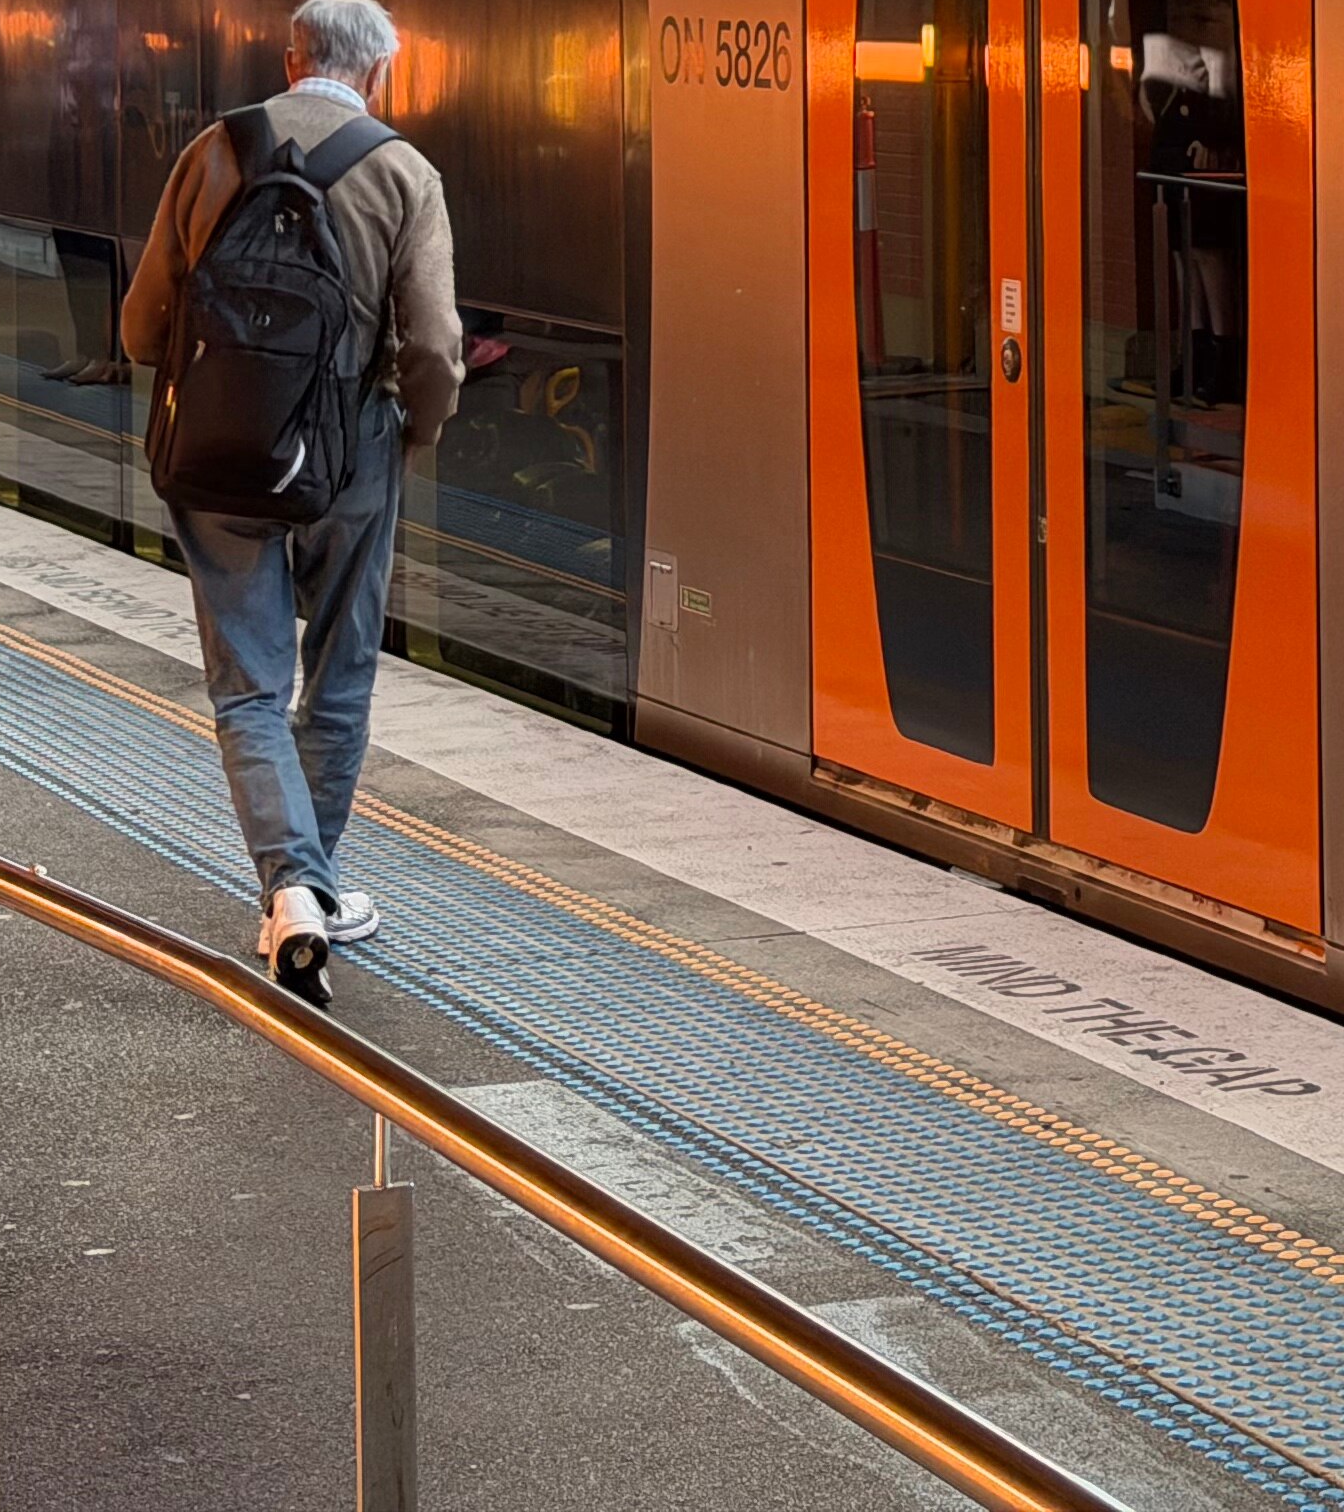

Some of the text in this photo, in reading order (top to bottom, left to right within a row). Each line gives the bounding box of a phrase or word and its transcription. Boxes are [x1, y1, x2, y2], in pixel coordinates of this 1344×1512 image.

[716, 20, 792, 91] 5826
[909, 944, 1322, 1096] MIND THE GAP
